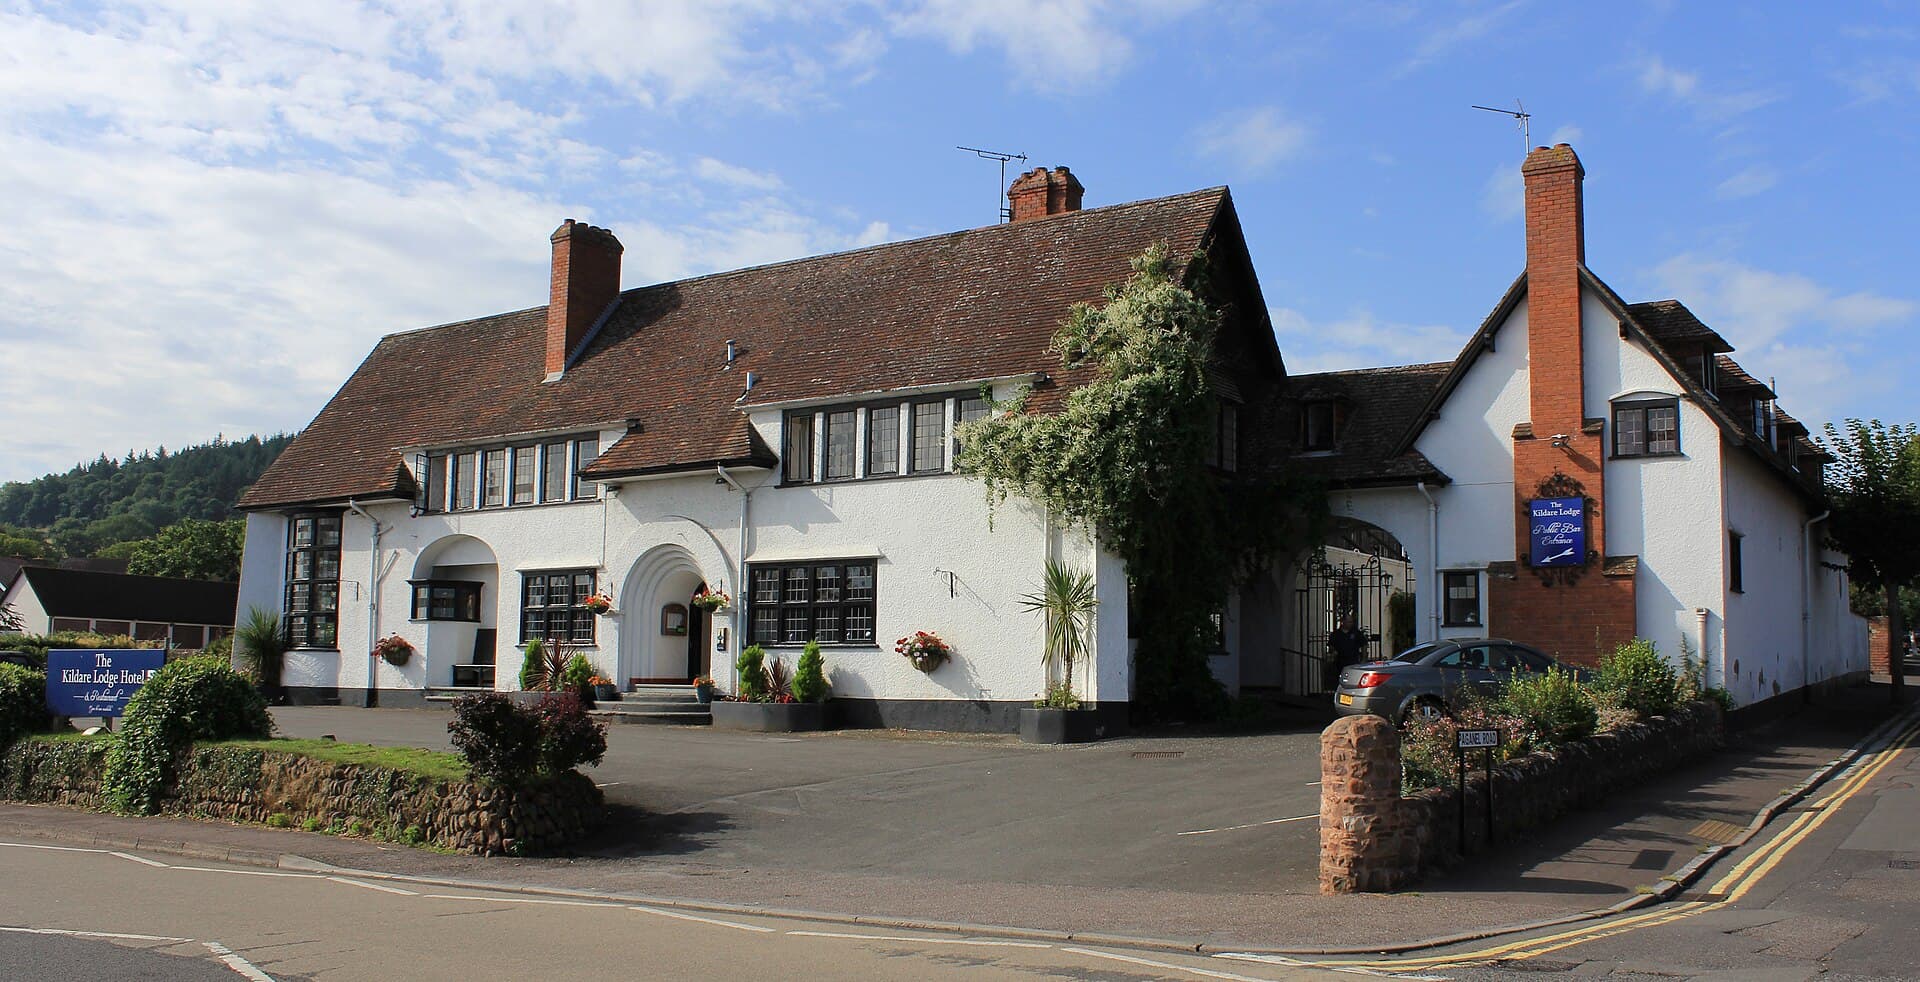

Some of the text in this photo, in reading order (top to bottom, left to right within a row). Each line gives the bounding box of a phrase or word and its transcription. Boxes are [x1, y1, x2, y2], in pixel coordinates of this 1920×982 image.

[1533, 508, 1580, 517] Kildare Lodge
[1532, 522, 1581, 534] Public Bar
[1541, 533, 1573, 545] Entrance
[95, 653, 112, 667] The
[62, 669, 145, 688] Kildare Lodge Hotel
[1483, 732, 1496, 745] ROAD
